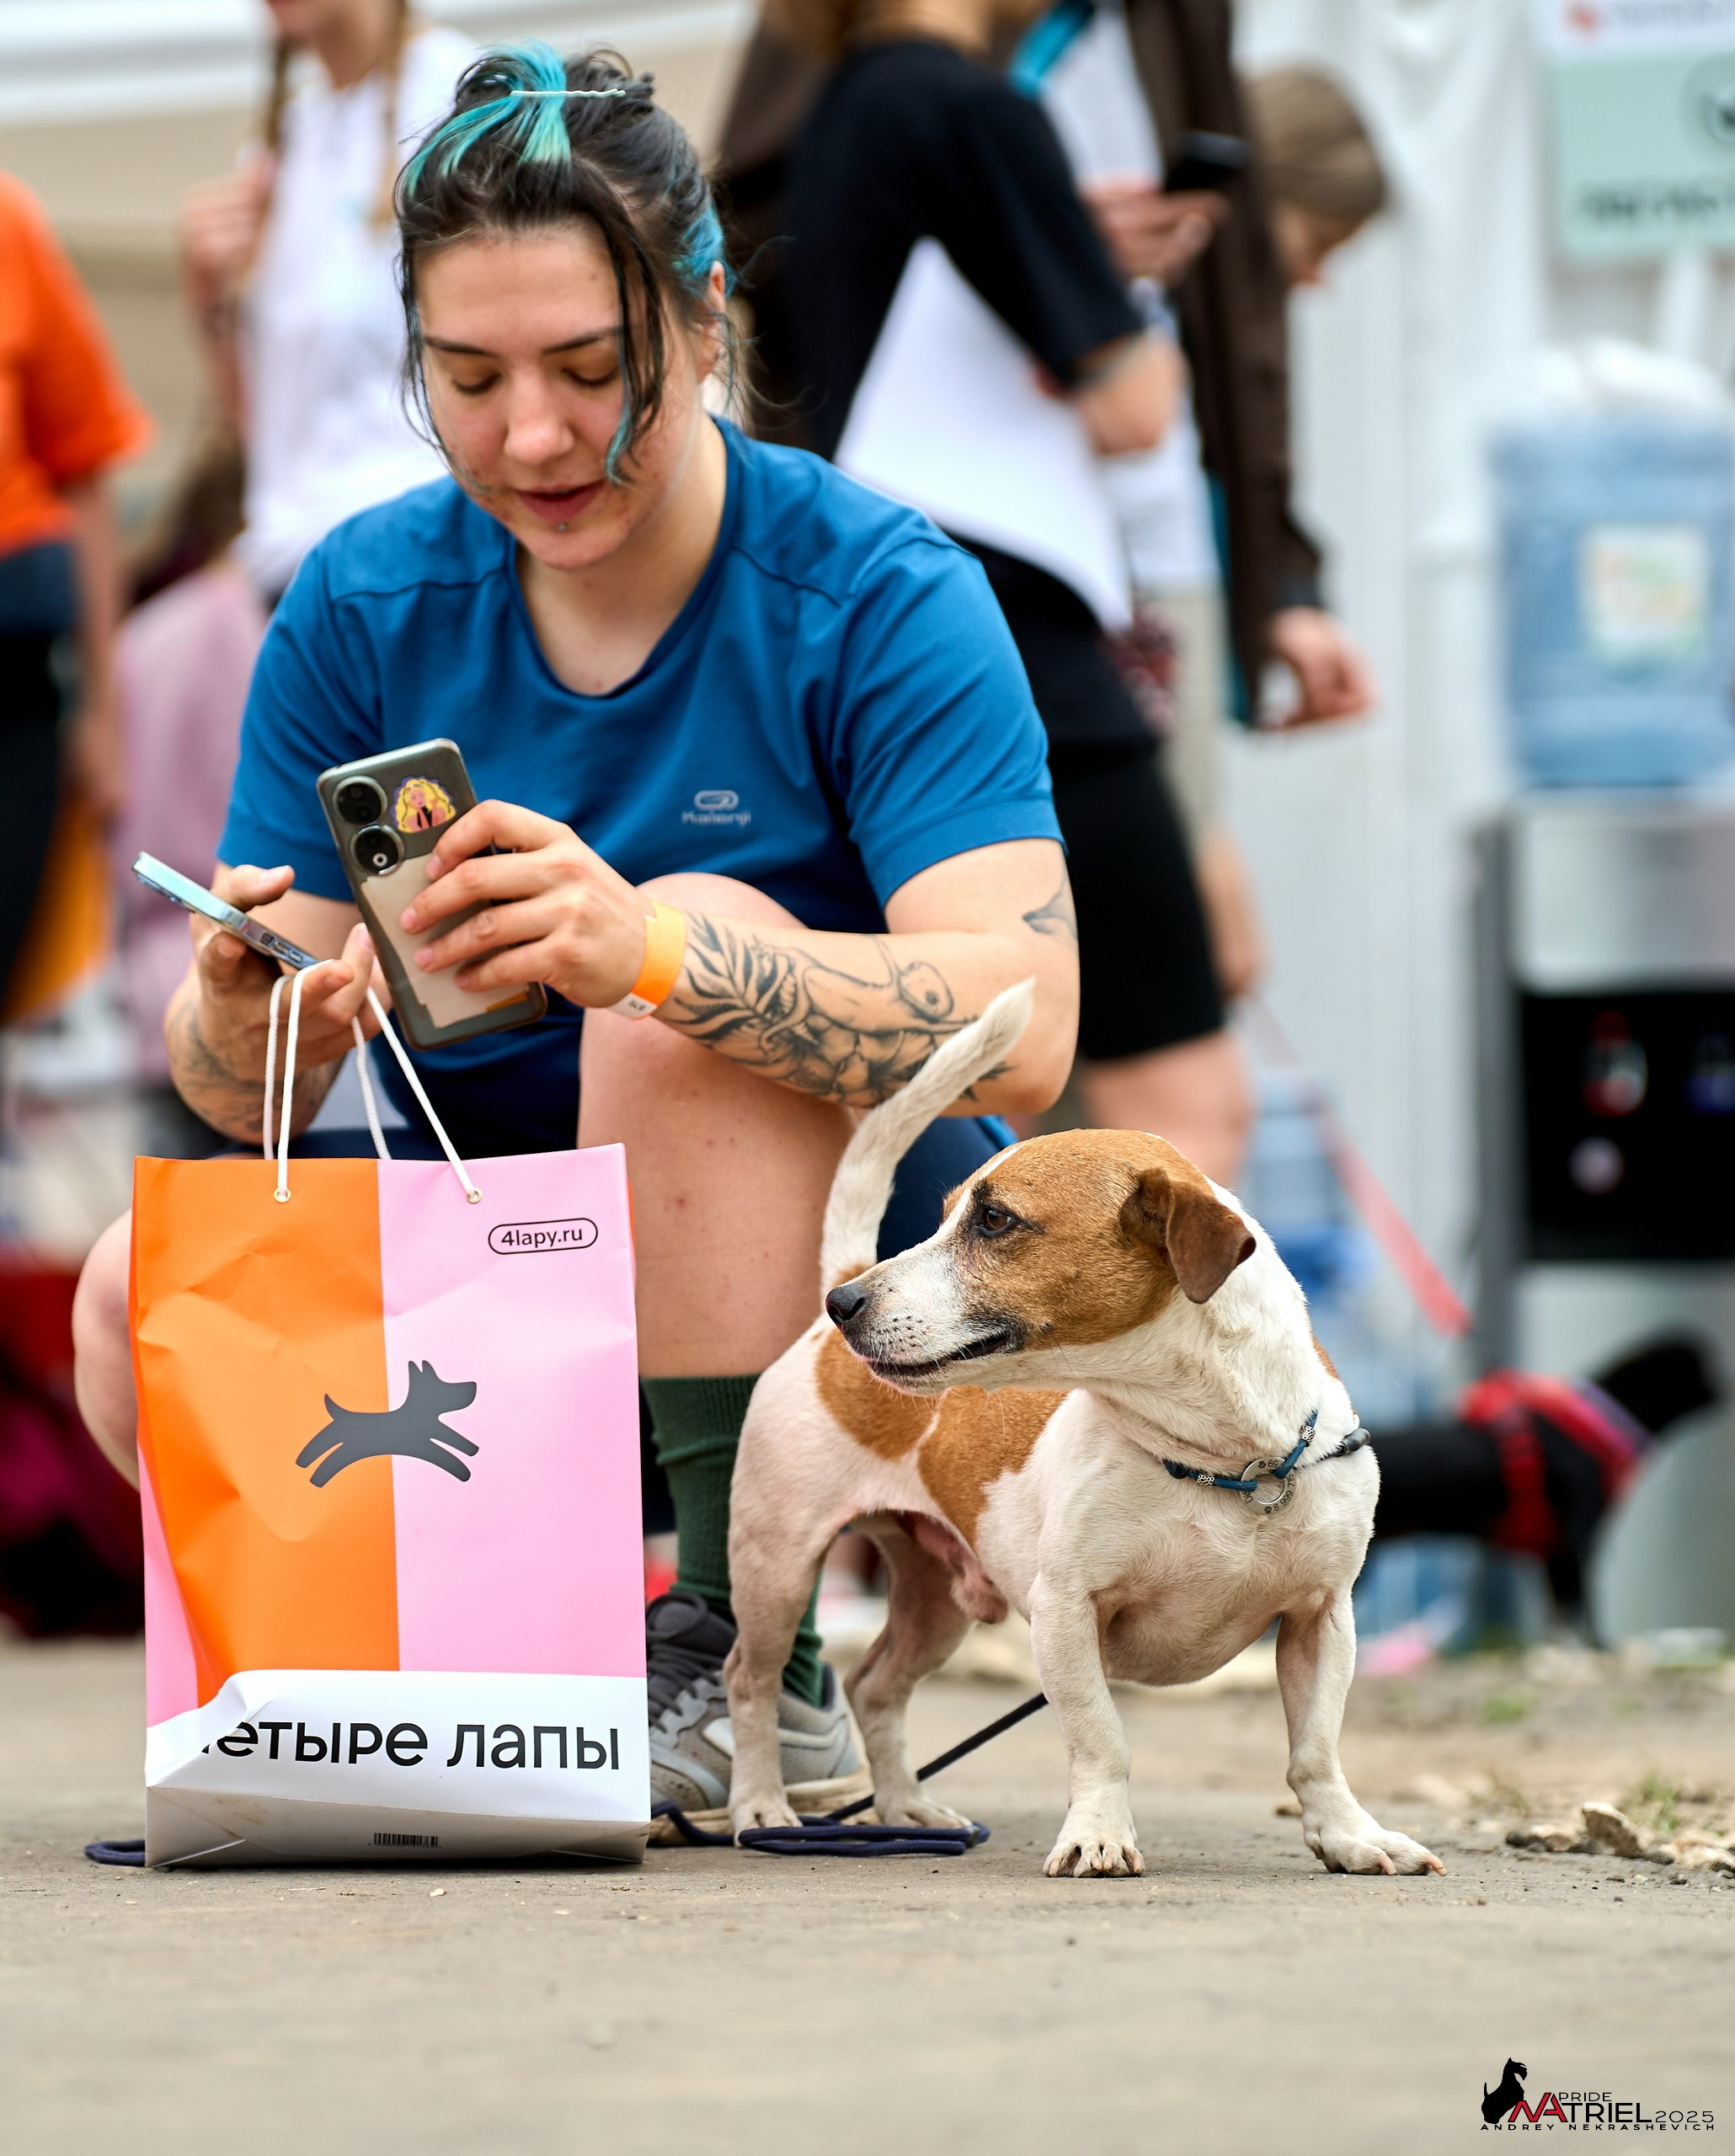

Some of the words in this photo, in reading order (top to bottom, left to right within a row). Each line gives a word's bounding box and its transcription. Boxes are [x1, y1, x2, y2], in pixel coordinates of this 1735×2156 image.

[500, 1228, 583, 1248] 4lapy.ru
[201, 1721, 428, 1767] етыре
[446, 1724, 619, 1769] лапы
